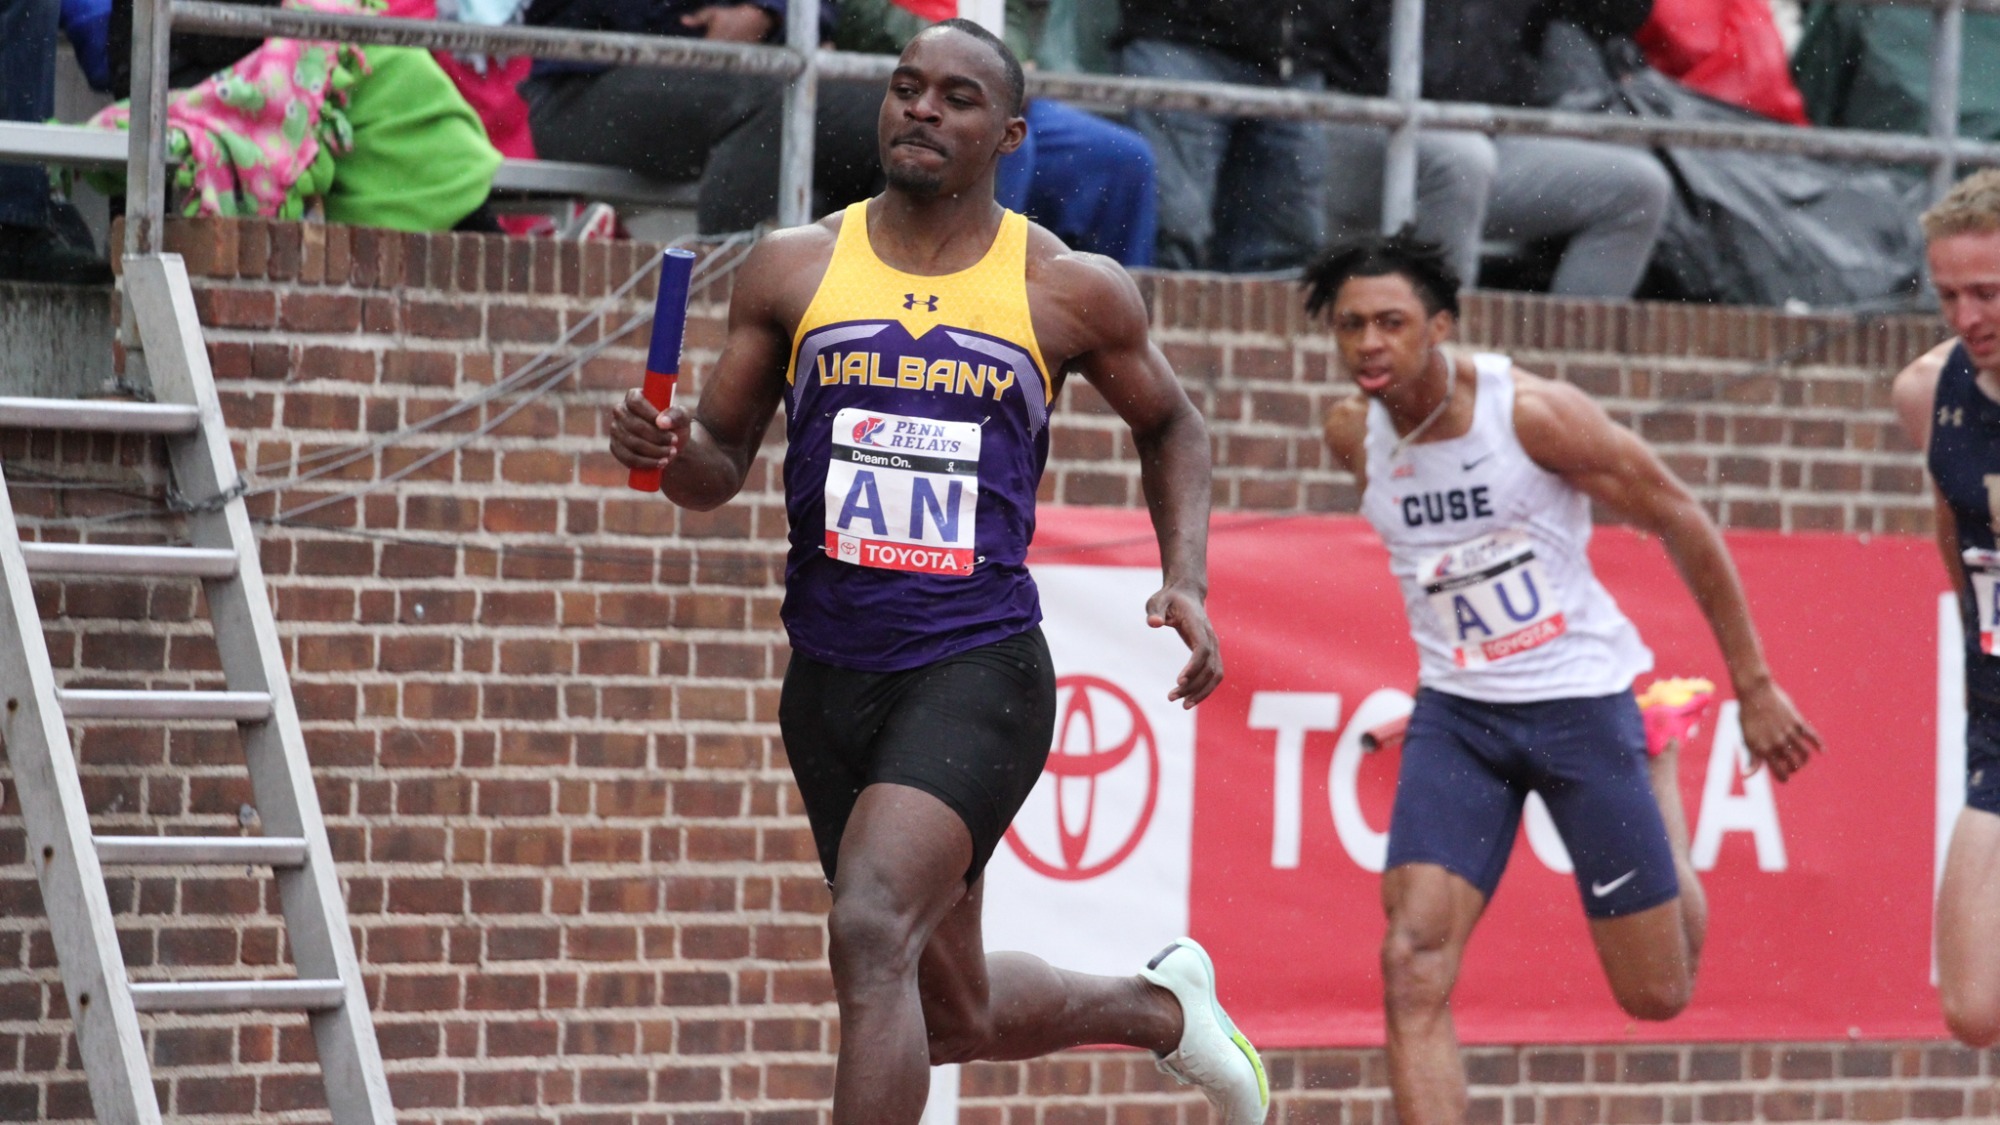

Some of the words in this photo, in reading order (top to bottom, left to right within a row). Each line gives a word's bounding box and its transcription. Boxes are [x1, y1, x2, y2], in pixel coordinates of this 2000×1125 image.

[816, 351, 1015, 401] UALBANY
[894, 421, 946, 437] PENN
[890, 435, 961, 453] RELAYS
[852, 450, 888, 466] Dream
[890, 456, 911, 468] On.
[1402, 486, 1494, 527] CUSE
[865, 544, 958, 570] TOYOTA
